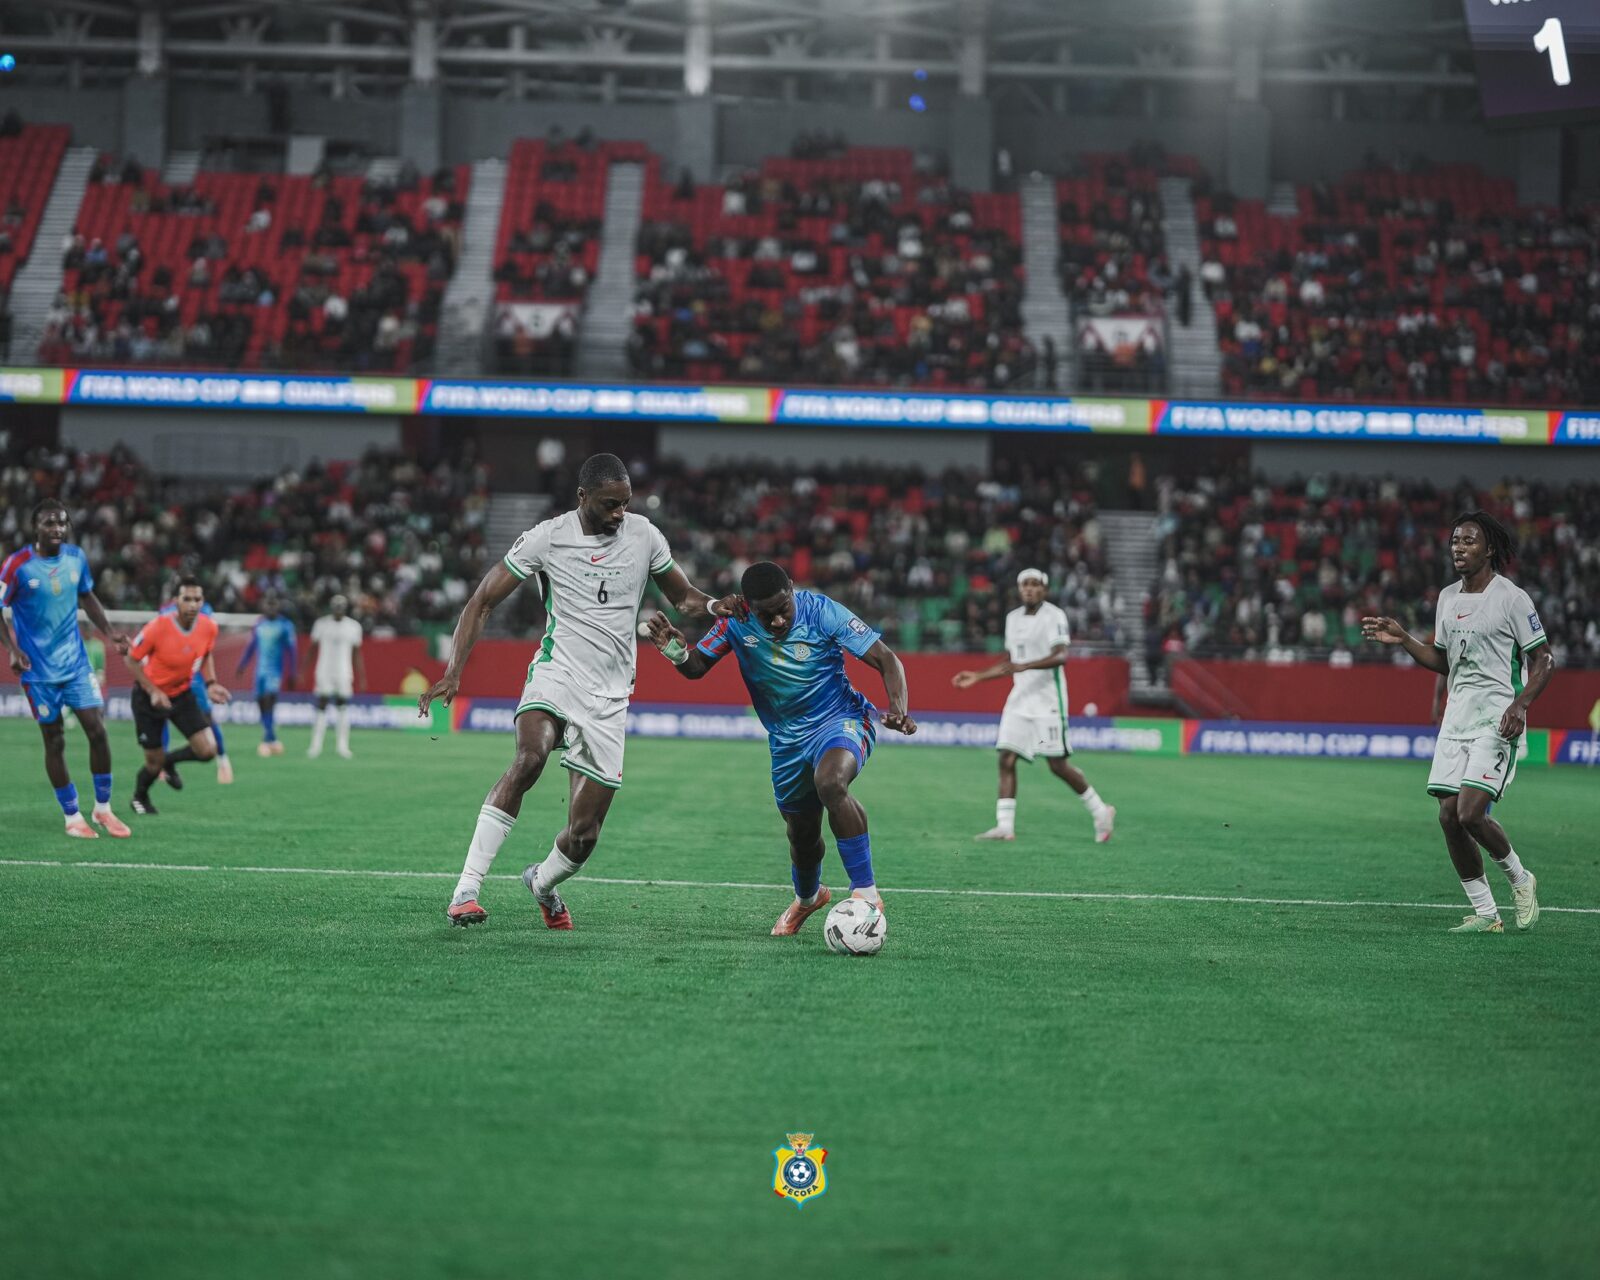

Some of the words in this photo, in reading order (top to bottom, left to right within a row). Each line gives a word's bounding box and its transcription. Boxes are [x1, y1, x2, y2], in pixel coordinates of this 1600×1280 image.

[1533, 17, 1571, 86] 1
[80, 375, 125, 398] FIFA
[126, 376, 199, 401] WORLD
[200, 379, 240, 403] CUP
[1171, 406, 1225, 430] FIFA
[1225, 407, 1313, 433] WORLD
[1315, 410, 1364, 434] CUP
[1415, 413, 1528, 438] QUALIFIERS
[1567, 418, 1600, 440] FIF
[597, 580, 608, 604] 6
[1459, 638, 1467, 660] 2
[1202, 730, 1248, 753] FIFA
[1249, 731, 1324, 755] WORLD
[1325, 733, 1367, 757] CUP
[1494, 751, 1505, 773] 2
